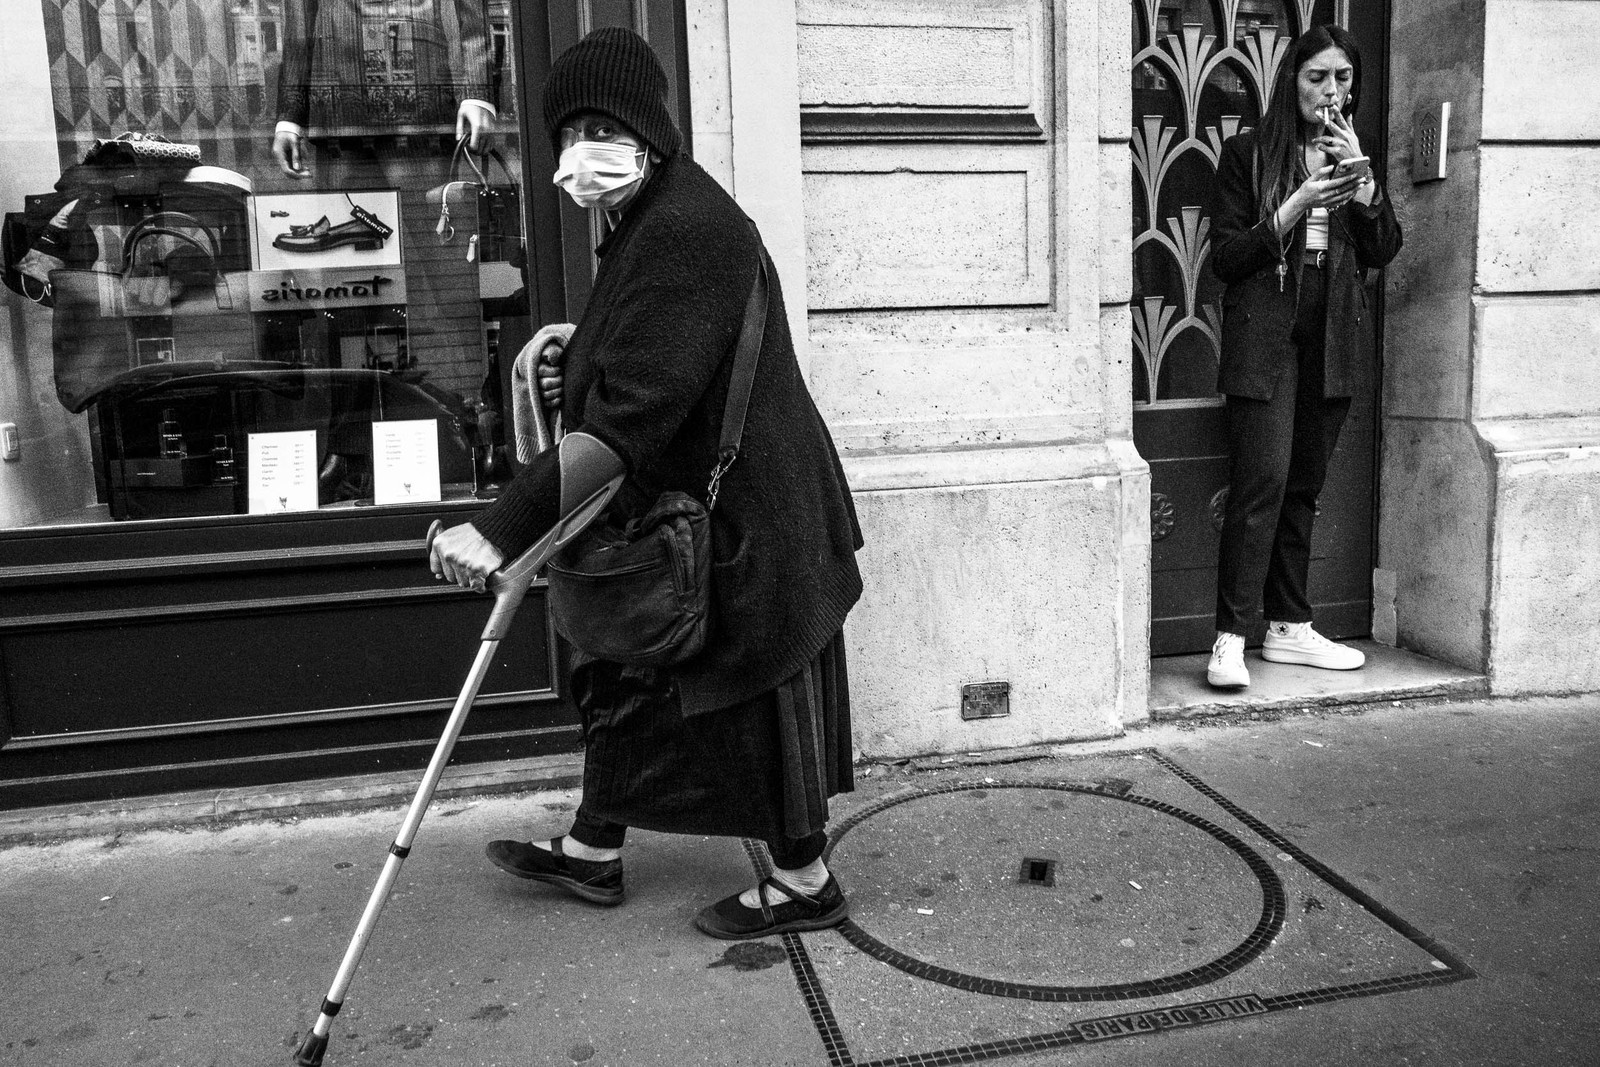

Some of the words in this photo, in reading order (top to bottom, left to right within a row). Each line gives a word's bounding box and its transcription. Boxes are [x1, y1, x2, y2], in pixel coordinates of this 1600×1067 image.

[1154, 1009, 1191, 1026] DE
[1192, 998, 1264, 1020] VILLE
[1081, 1016, 1153, 1038] PARIS
